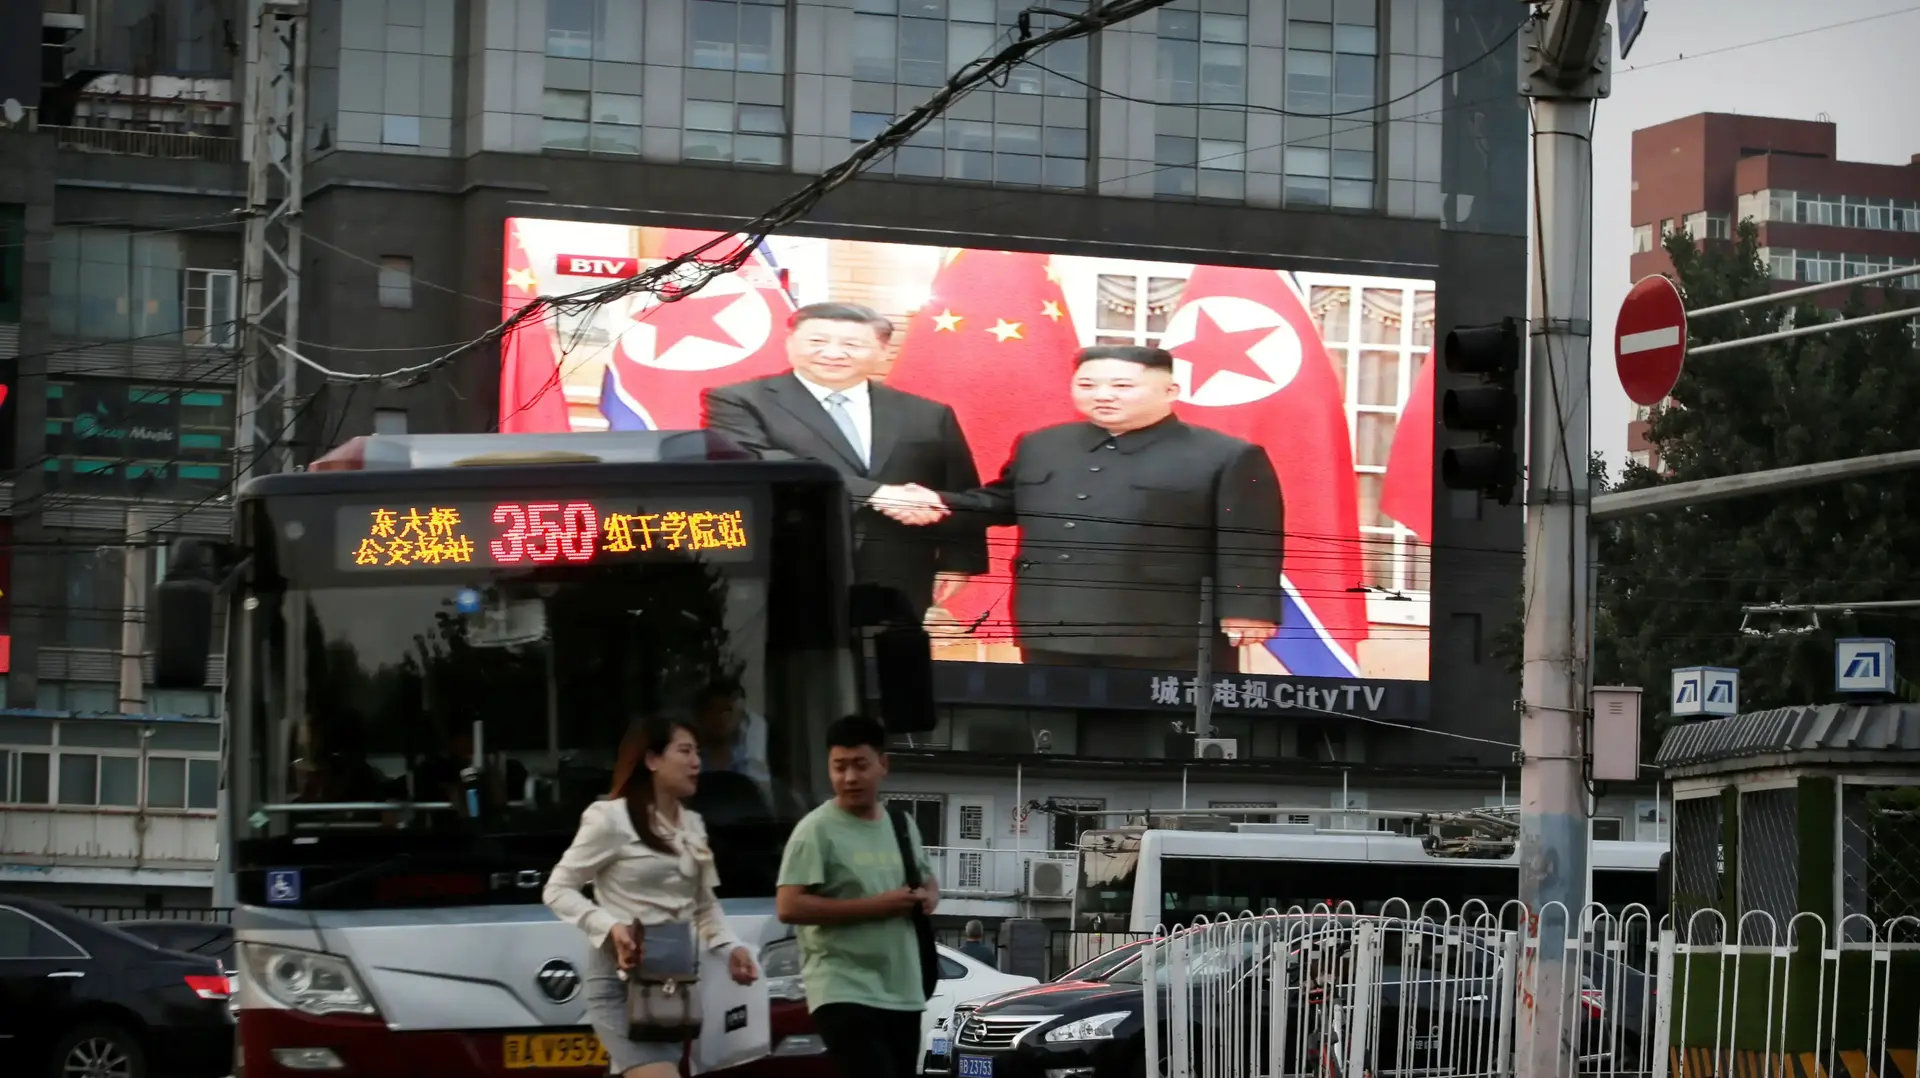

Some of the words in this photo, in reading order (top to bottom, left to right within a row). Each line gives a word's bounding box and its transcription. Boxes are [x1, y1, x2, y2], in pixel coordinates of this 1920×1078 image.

[569, 258, 626, 275] BTV
[371, 507, 461, 537] 东大桥
[490, 503, 598, 562] 350
[352, 535, 474, 565] 公交场站
[1150, 676, 1268, 709] 城市电视
[1273, 683, 1386, 712] CityTV
